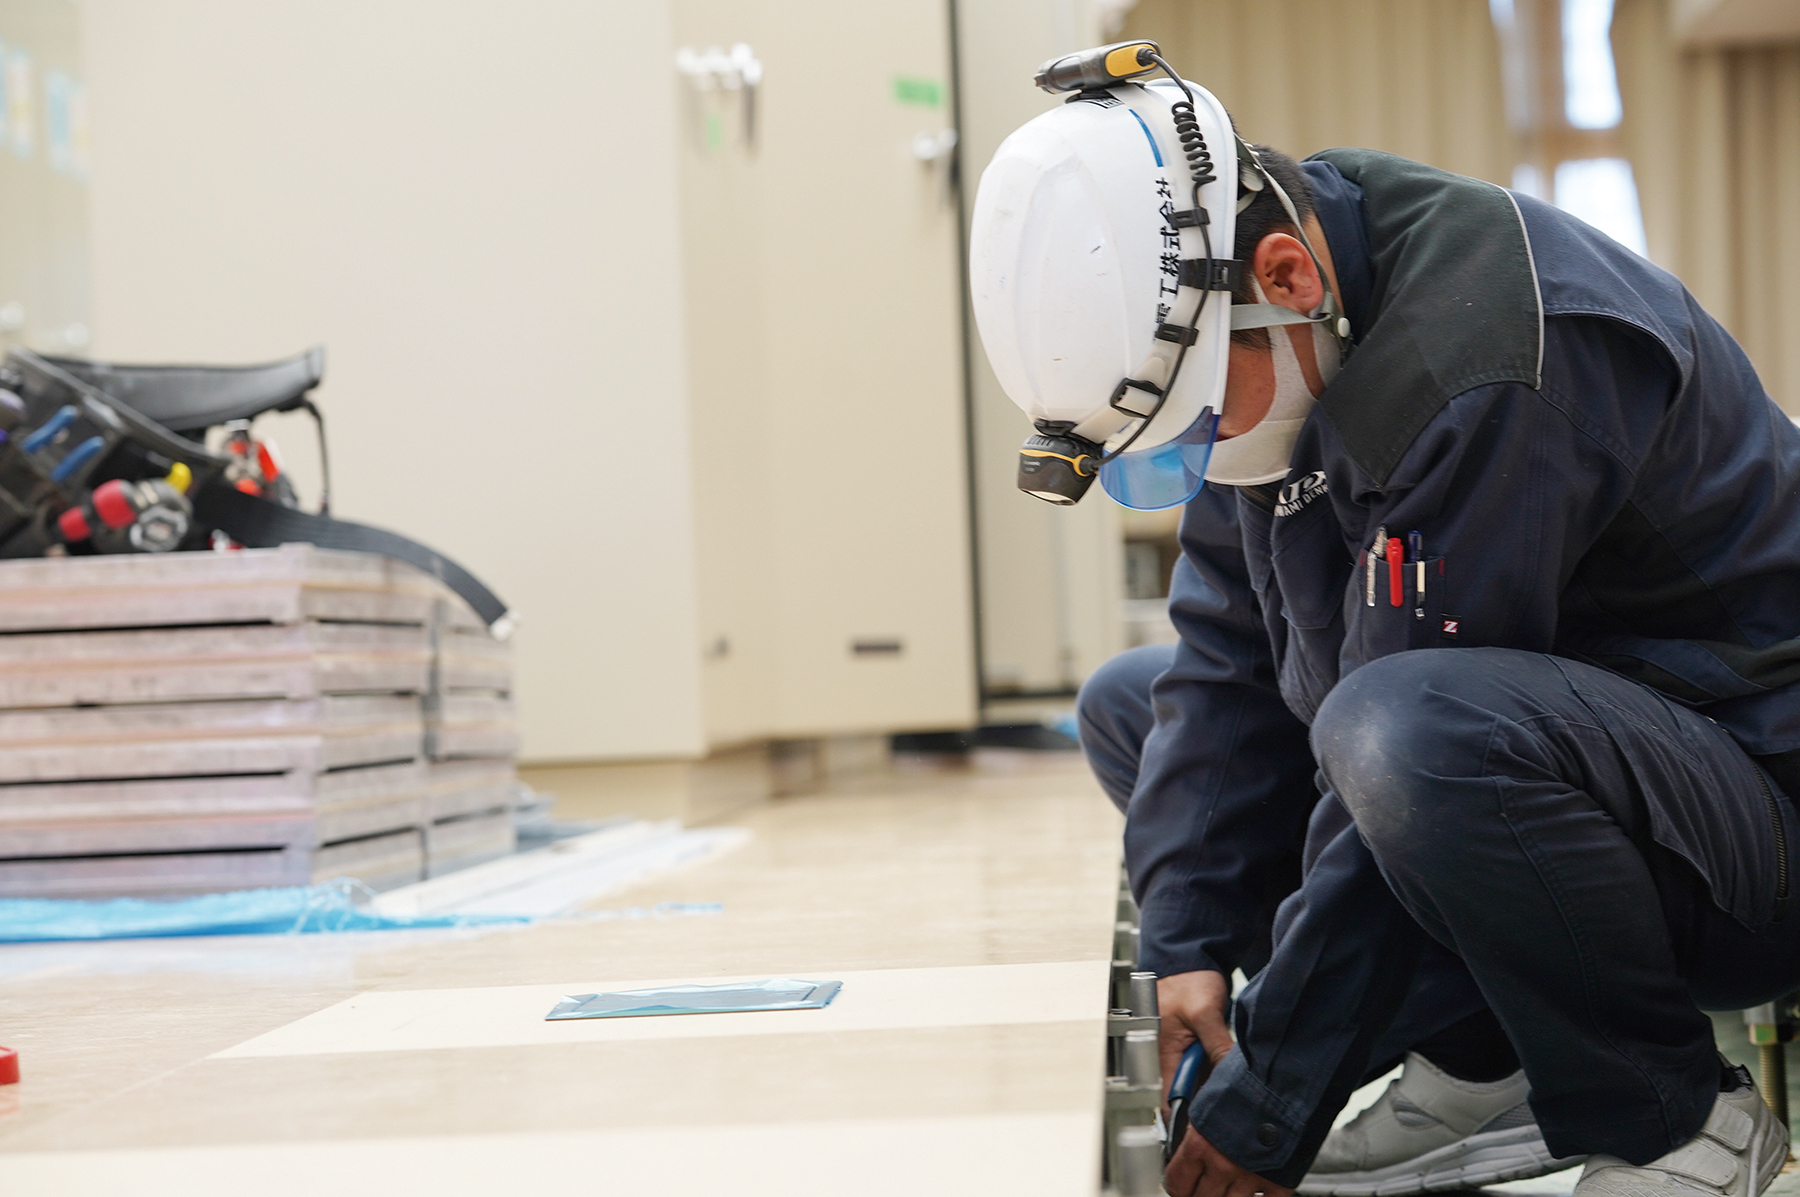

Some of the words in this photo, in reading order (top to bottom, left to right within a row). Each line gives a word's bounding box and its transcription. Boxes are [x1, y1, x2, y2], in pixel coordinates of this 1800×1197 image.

[1154, 177, 1181, 340] 電工株式会社
[1443, 620, 1458, 632] Z
